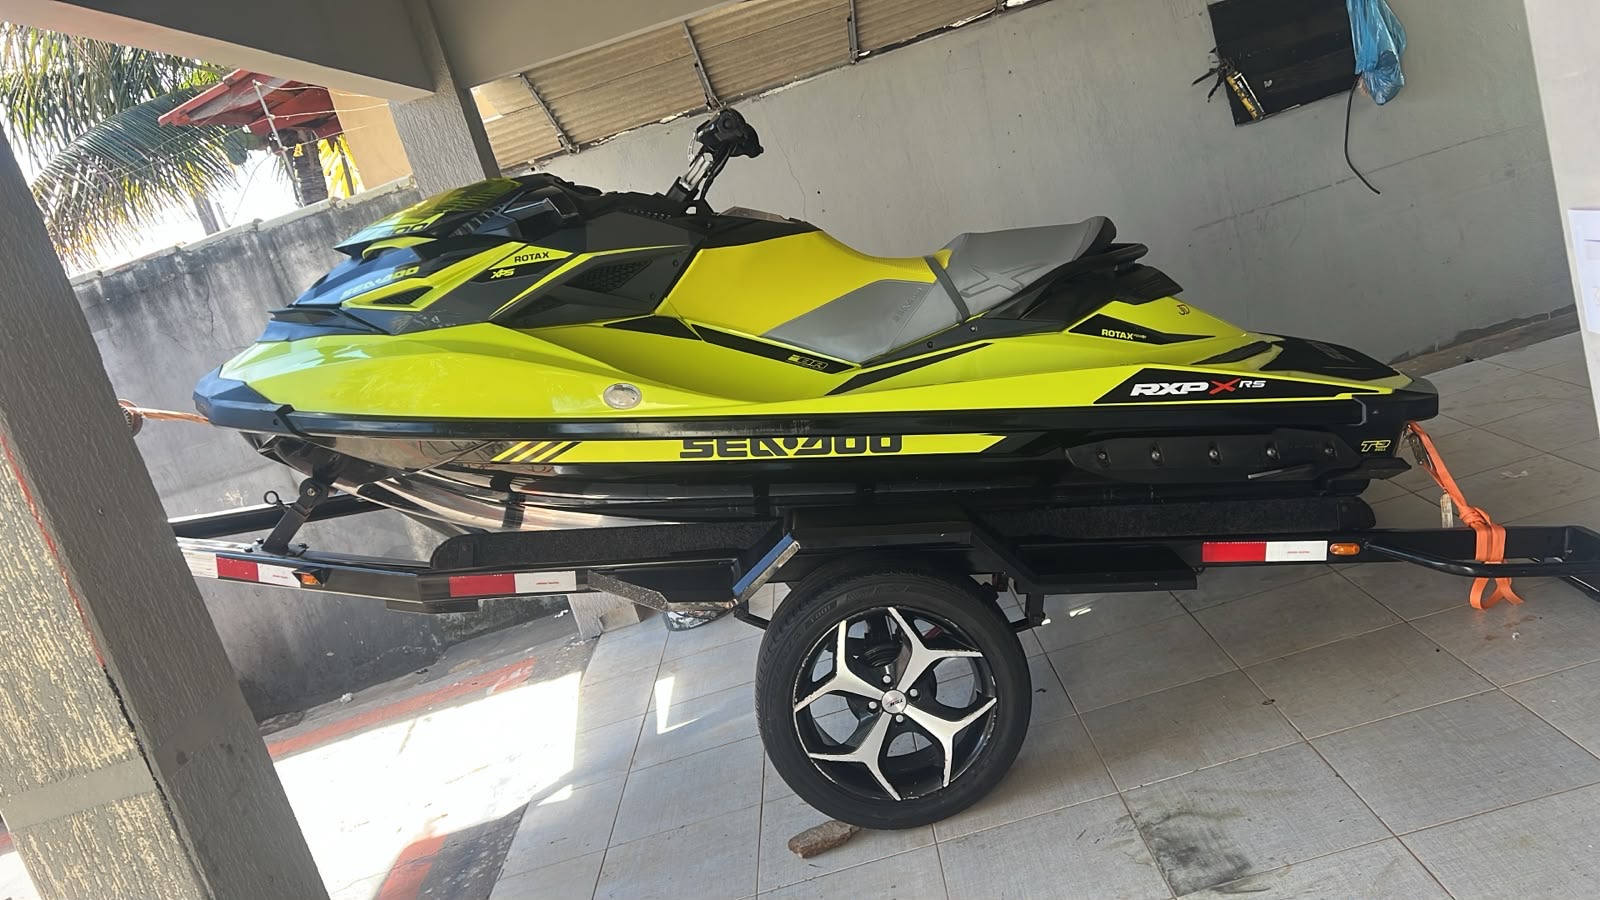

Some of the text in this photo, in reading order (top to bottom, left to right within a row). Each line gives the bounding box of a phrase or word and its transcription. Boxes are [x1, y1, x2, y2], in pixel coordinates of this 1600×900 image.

[514, 251, 550, 263] ROTAX
[1101, 328, 1134, 340] ROTAX
[1129, 381, 1210, 397] RXP
[1238, 380, 1267, 389] RS
